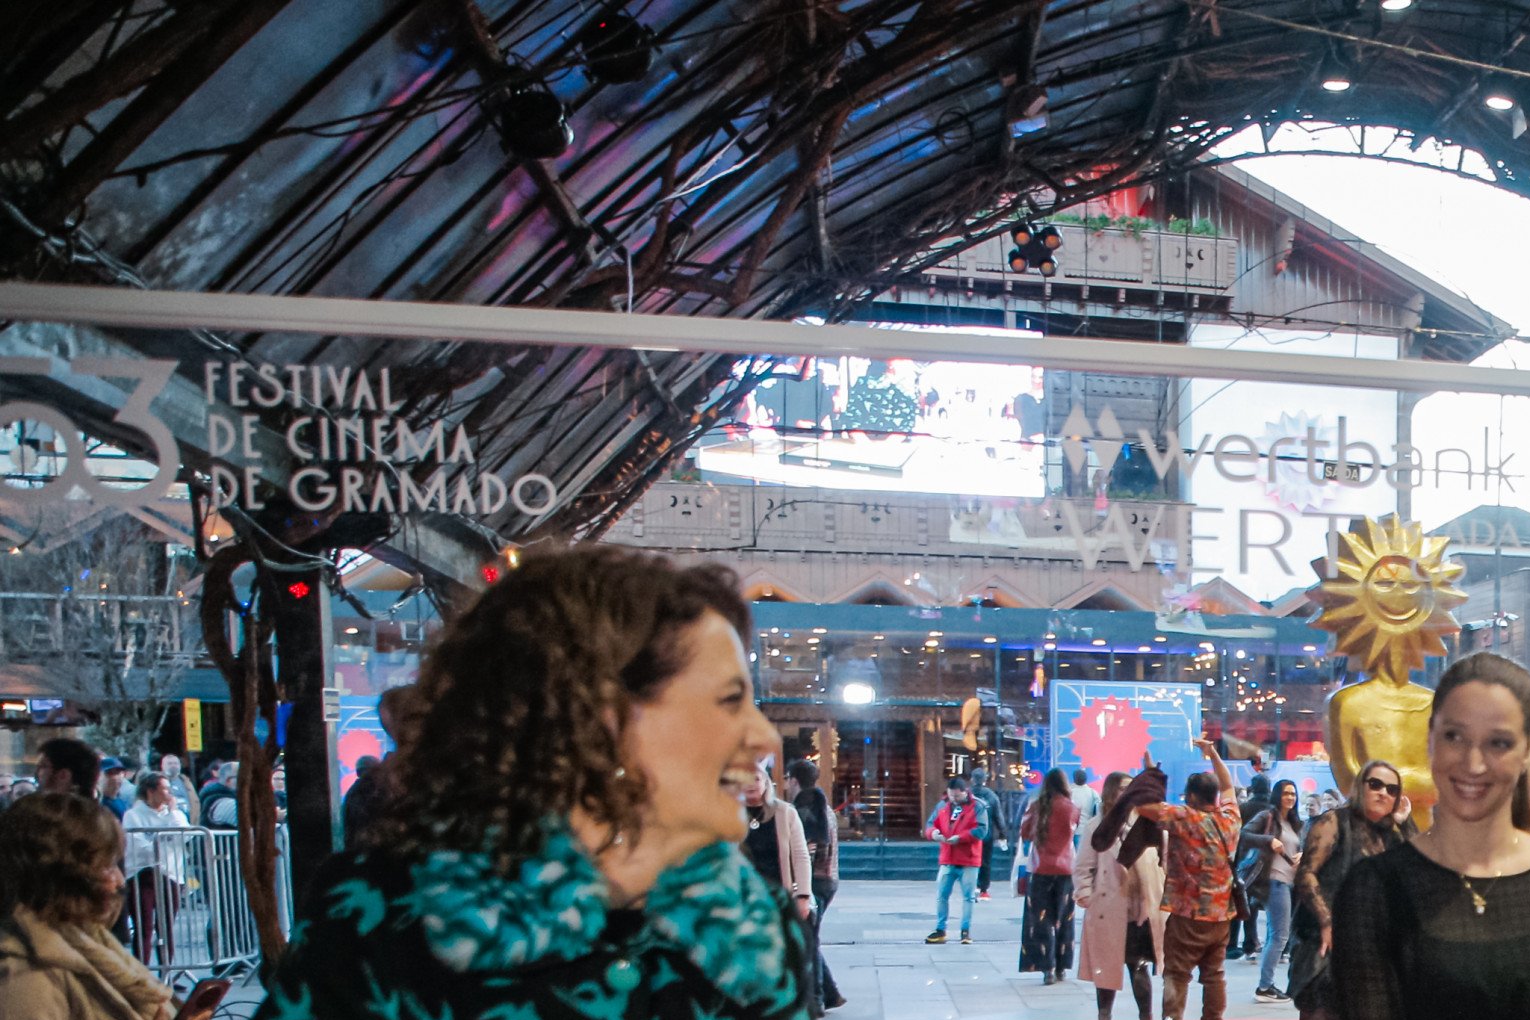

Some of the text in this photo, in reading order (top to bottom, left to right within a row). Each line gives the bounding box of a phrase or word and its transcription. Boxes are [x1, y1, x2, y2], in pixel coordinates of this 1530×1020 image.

[204, 361, 399, 411] FESTIVAL
[209, 414, 475, 464] DE CINEMA
[1138, 415, 1517, 494] wertbank
[212, 466, 557, 515] DE GRAMADO
[1324, 464, 1359, 481] SADA
[1063, 501, 1366, 579] WERT
